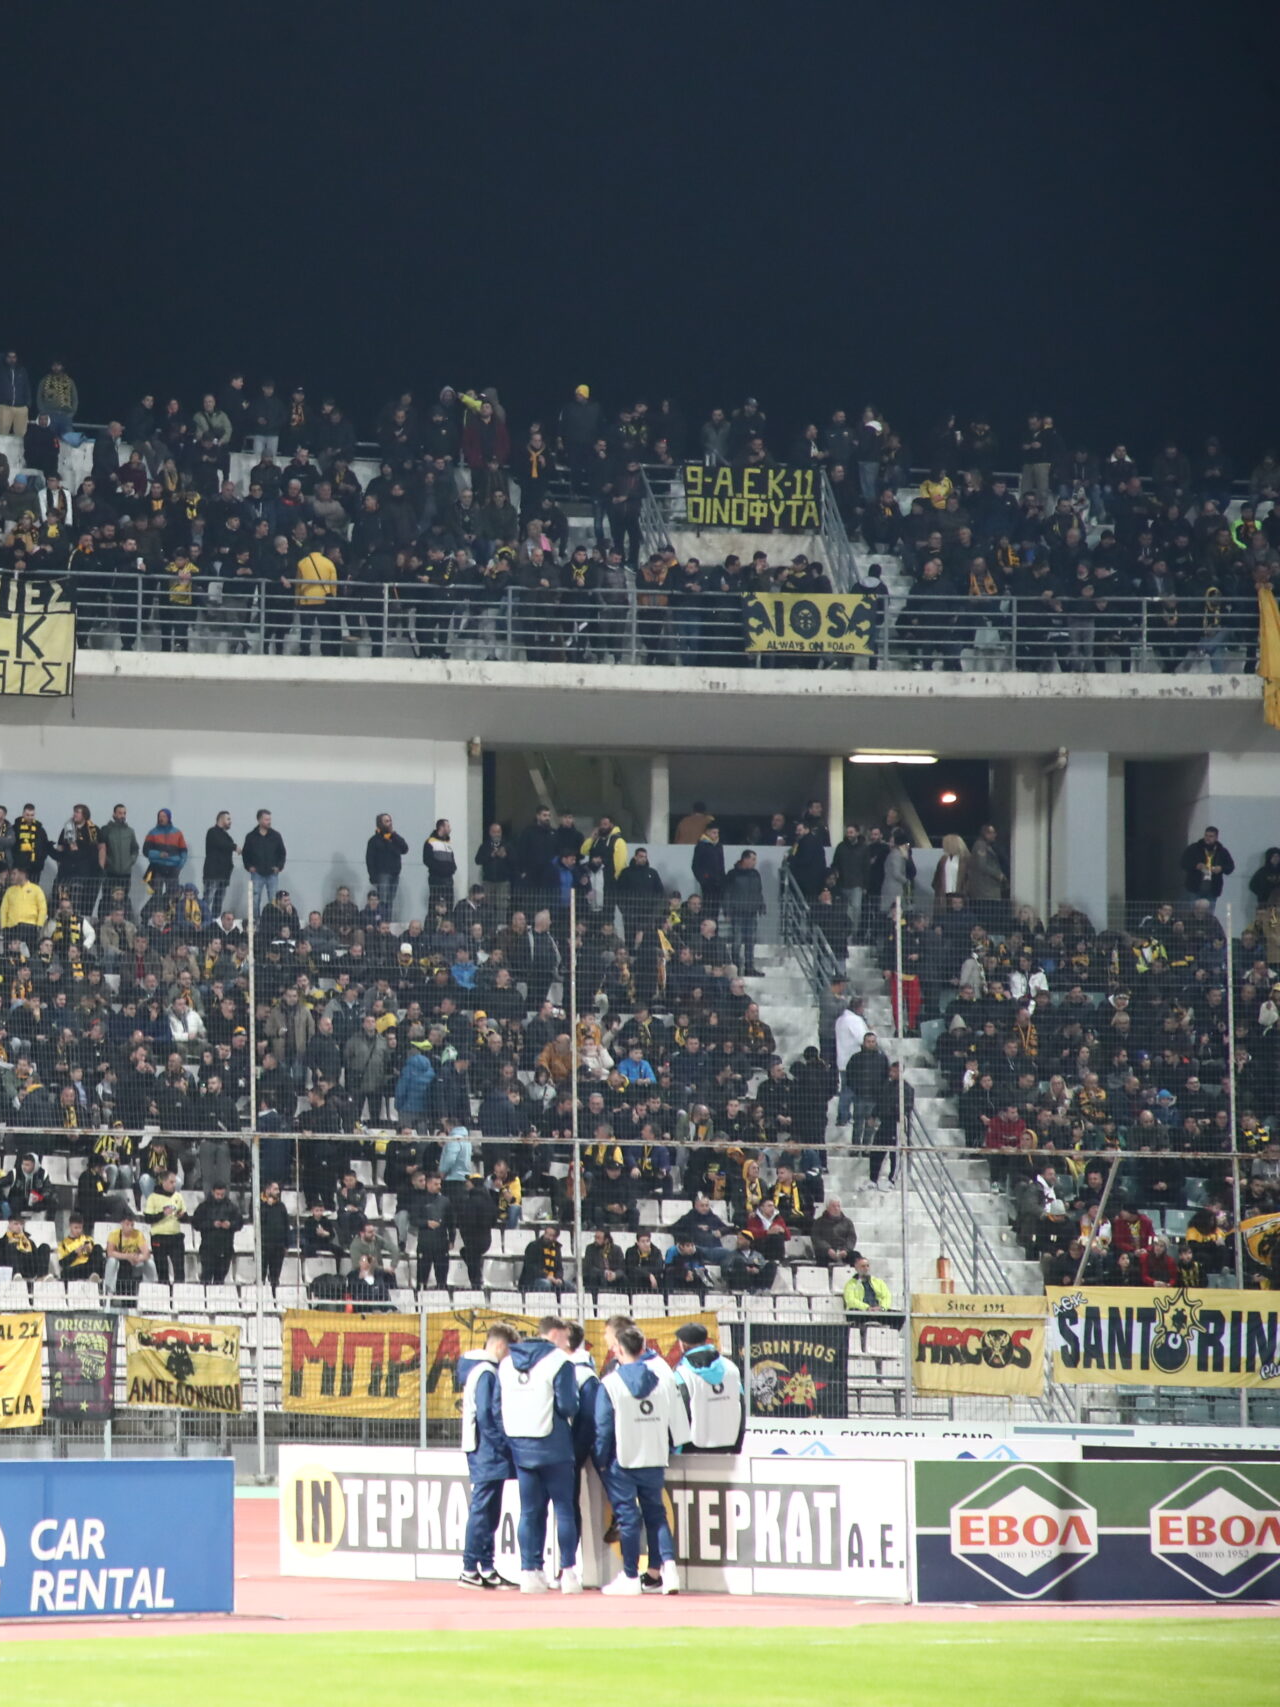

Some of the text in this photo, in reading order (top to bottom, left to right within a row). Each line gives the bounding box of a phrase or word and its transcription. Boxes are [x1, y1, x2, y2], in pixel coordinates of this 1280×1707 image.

[687, 497, 820, 527] ΟΙΝΟΦΥΤΑ
[773, 599, 850, 640] IOS
[947, 1300, 976, 1312] Since
[19, 1321, 40, 1340] 21
[915, 1325, 1034, 1369] ARGOS
[295, 1478, 472, 1551] ΙΝΤΕΡΚΑ
[31, 1518, 105, 1561] CAR
[1030, 1549, 1054, 1559] 1952
[1228, 1549, 1250, 1558] 1952
[31, 1567, 174, 1613] RENTAL
